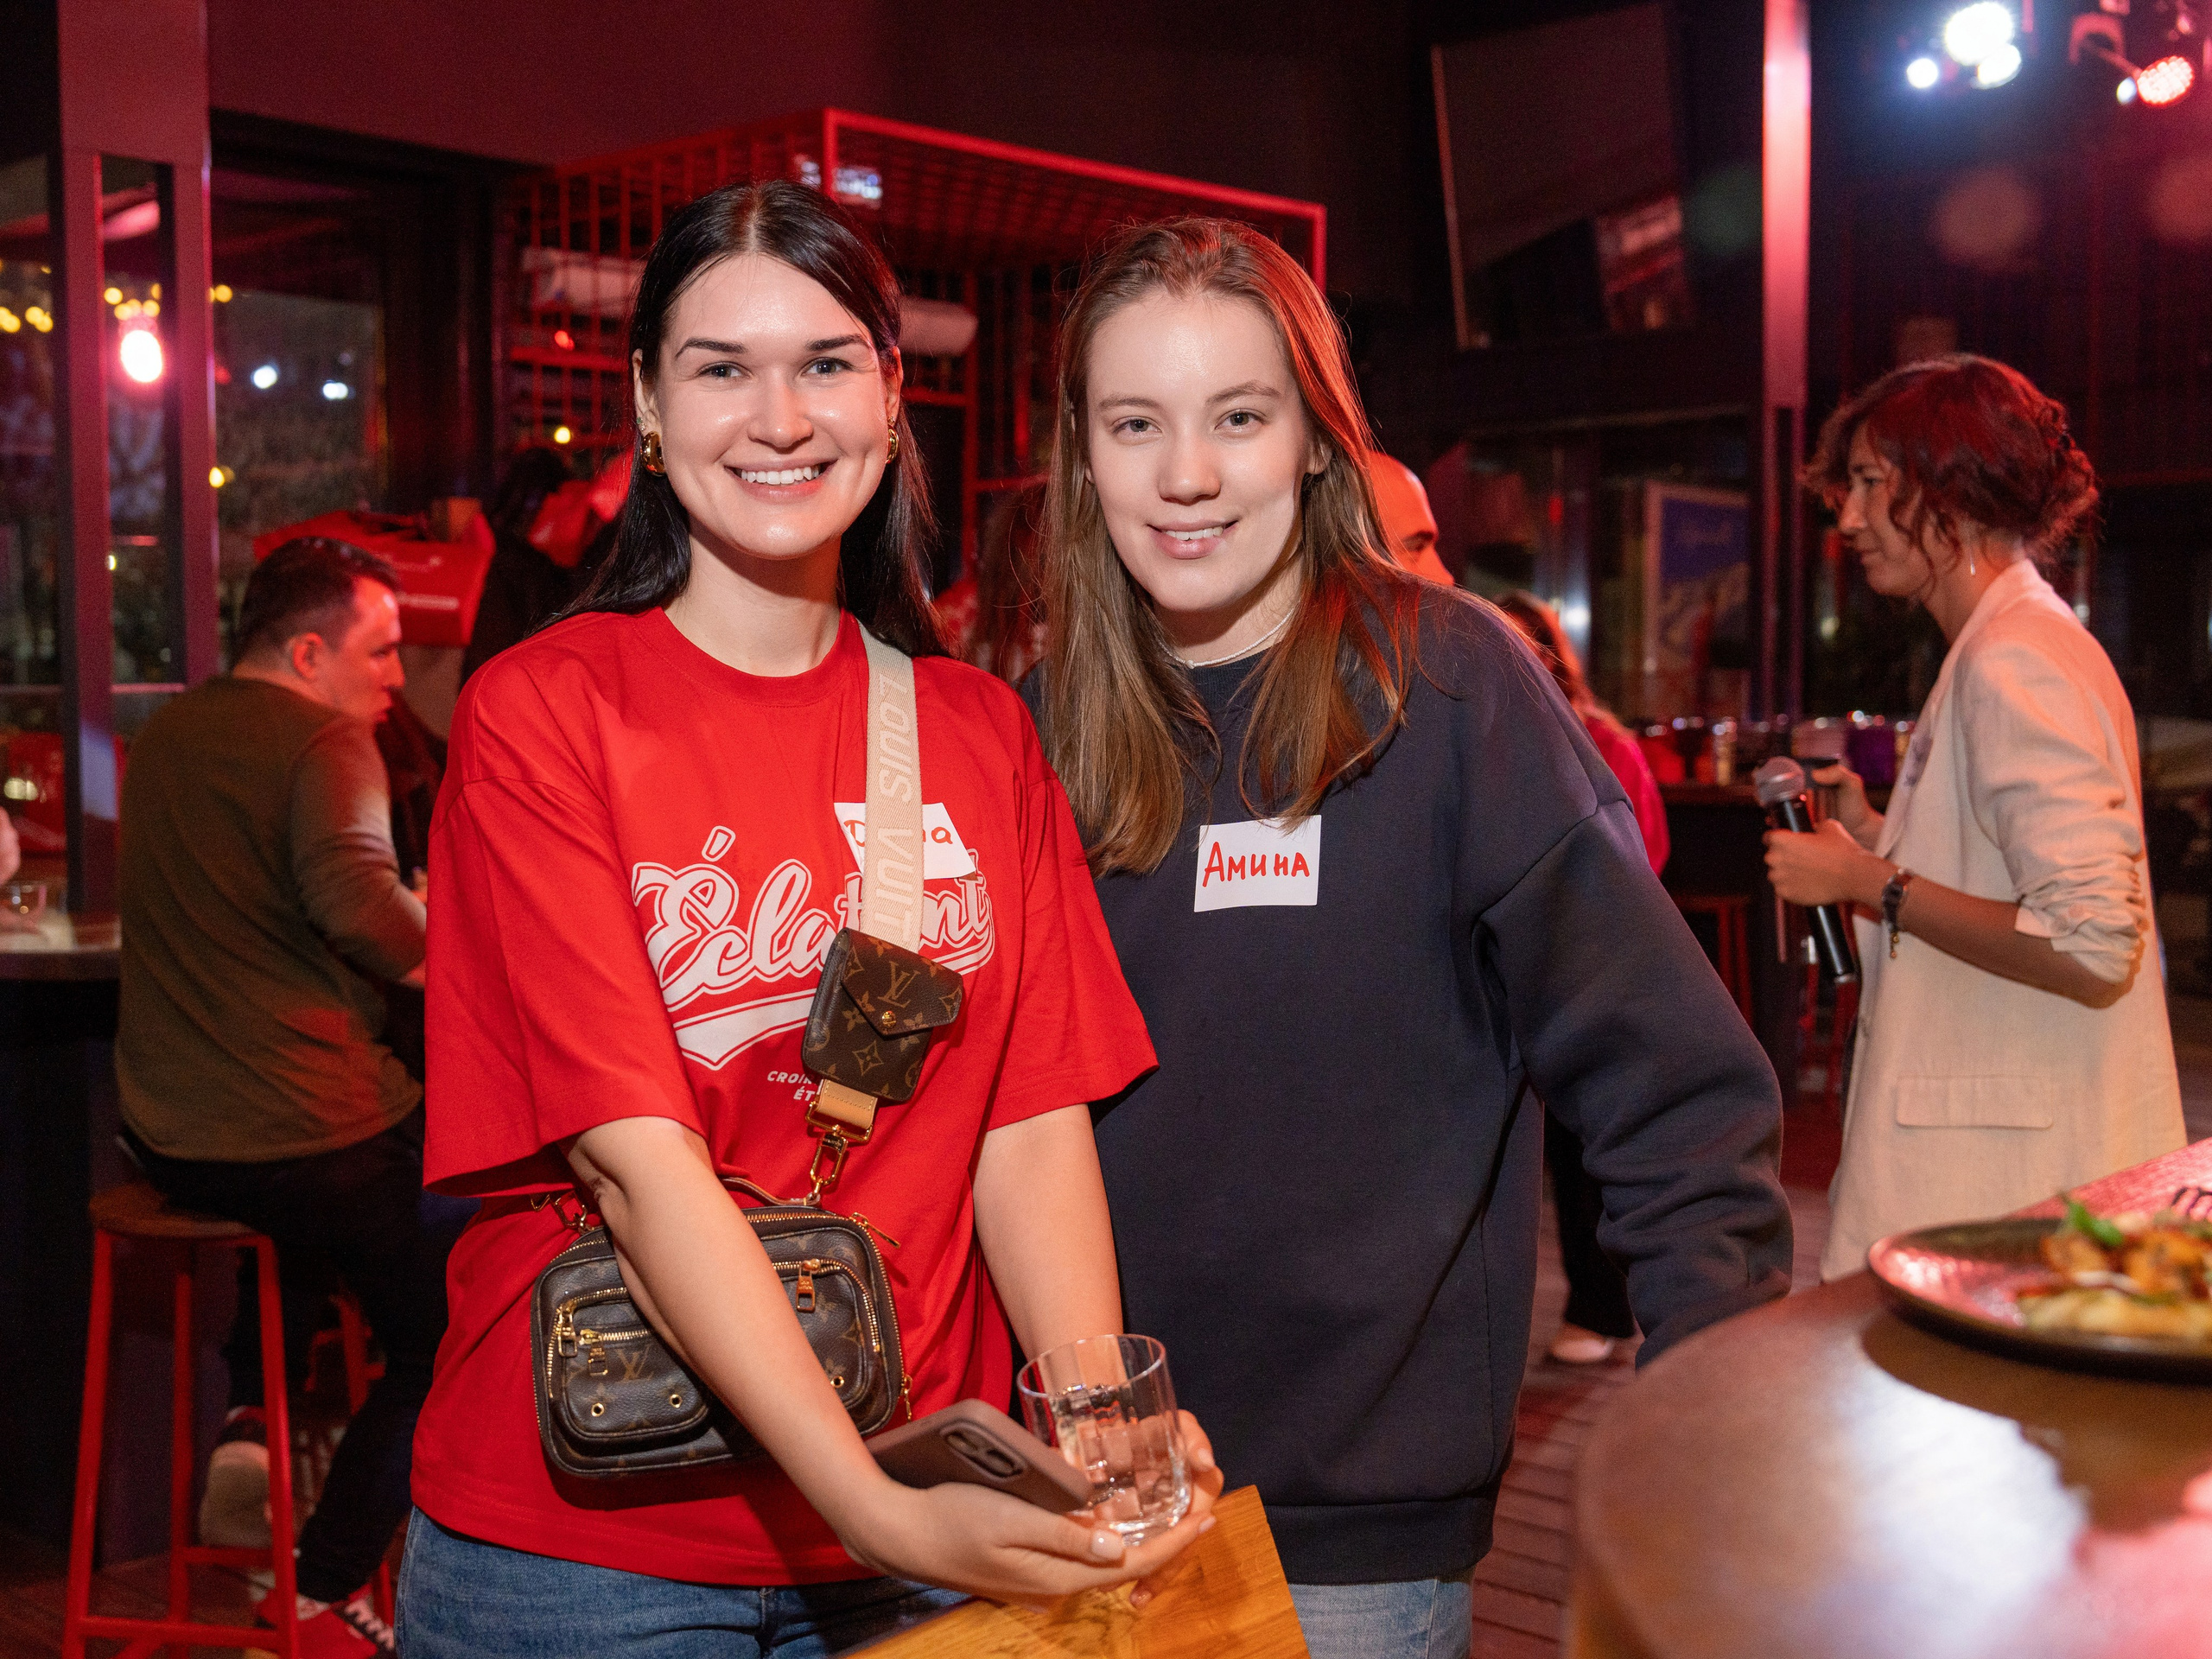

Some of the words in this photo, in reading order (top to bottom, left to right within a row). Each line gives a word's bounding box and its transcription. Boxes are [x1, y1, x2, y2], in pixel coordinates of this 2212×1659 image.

[879, 674, 912, 803] LOUIS
[632, 825, 995, 1013] Éclatnt
[874, 828, 914, 943] VUIT
[792, 1085, 816, 1102] ÉT
